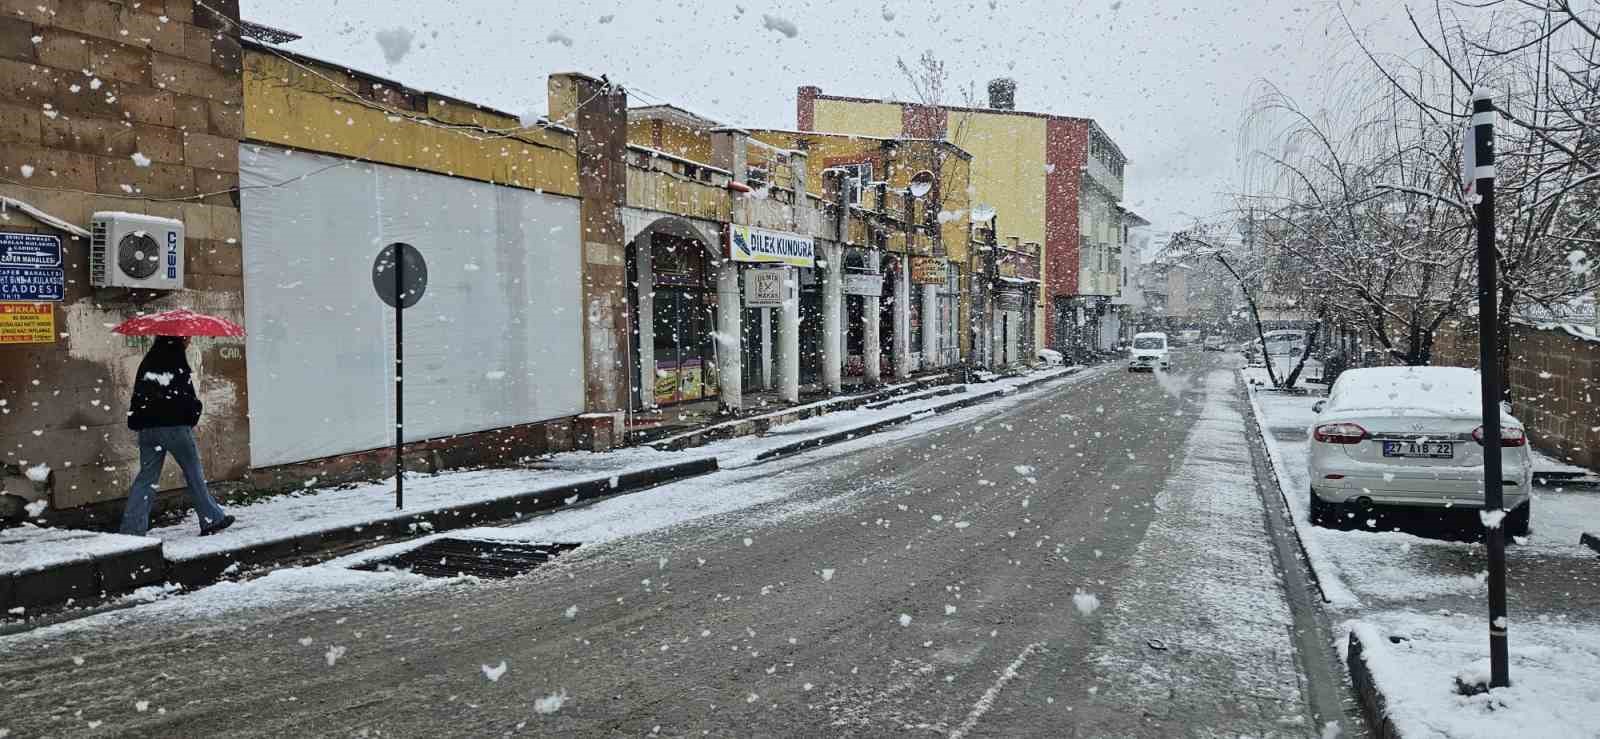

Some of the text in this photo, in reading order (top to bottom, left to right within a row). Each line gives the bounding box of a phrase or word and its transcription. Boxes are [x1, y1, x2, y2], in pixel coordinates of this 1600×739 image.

[168, 231, 176, 279] BEKO
[750, 233, 812, 257] DİLEK KUNDURA
[1391, 443, 1402, 453] 27
[1437, 444, 1450, 454] 22
